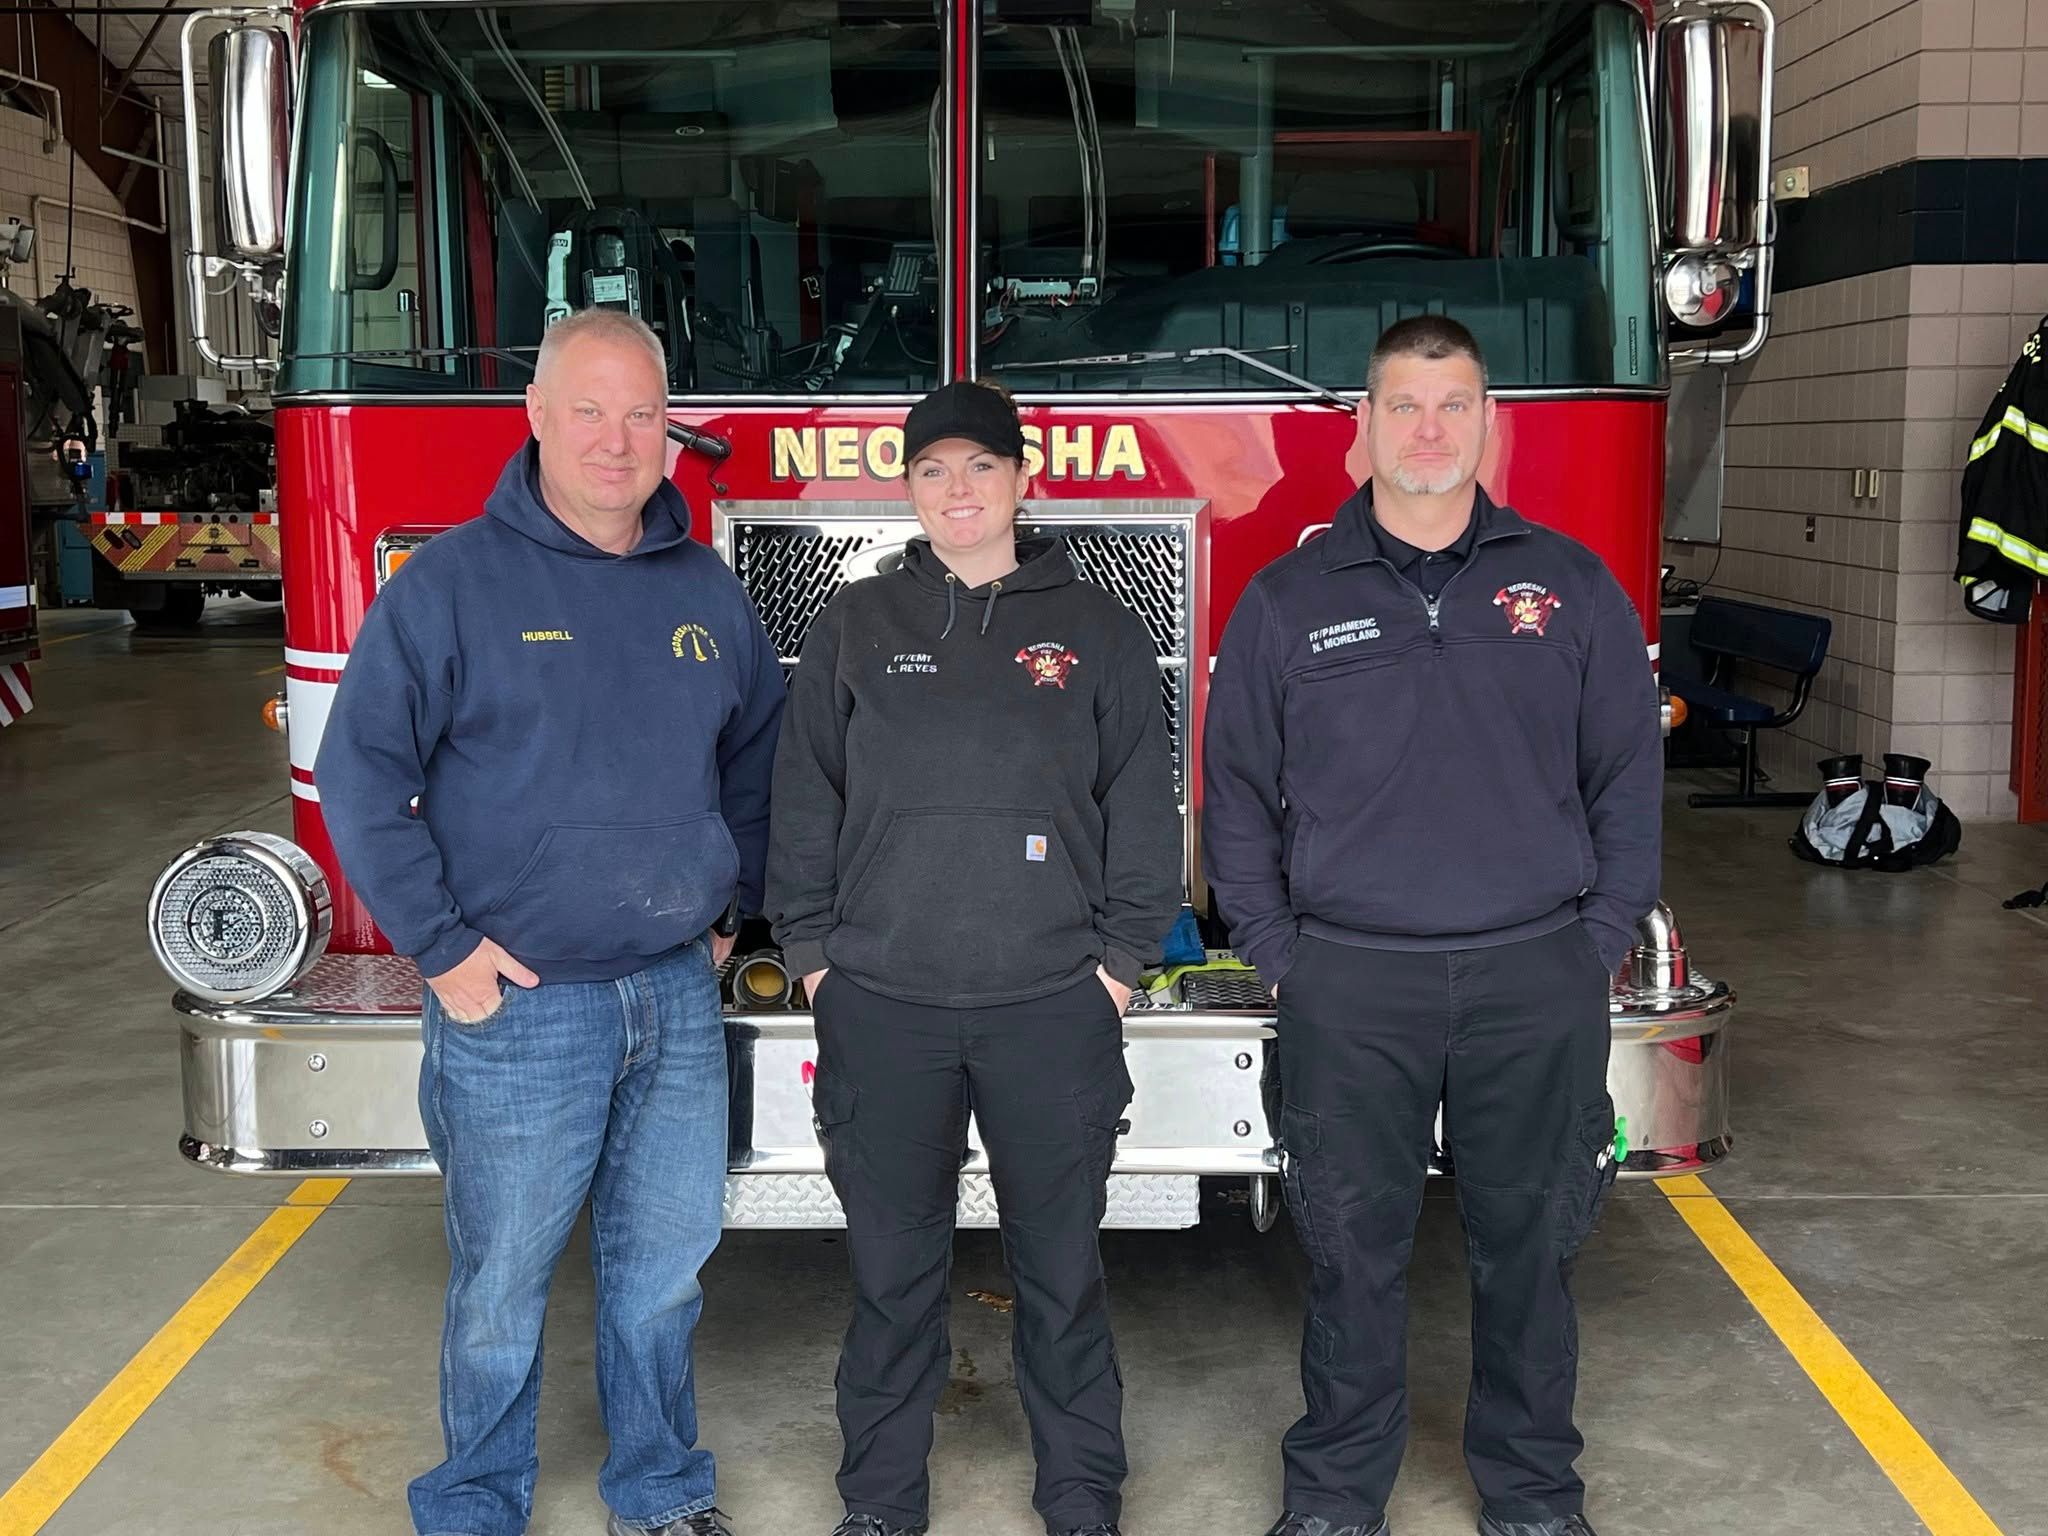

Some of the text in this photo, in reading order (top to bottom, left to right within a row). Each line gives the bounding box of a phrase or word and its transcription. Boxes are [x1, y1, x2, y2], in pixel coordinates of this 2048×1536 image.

[771, 424, 1147, 480] NEOSHA
[521, 630, 574, 642] HUBBELL
[1308, 617, 1377, 642] FF/PARAMEDIC
[1311, 628, 1381, 654] N. MORELAND
[893, 653, 932, 662] FF/EMT
[886, 663, 938, 674] L. REYES
